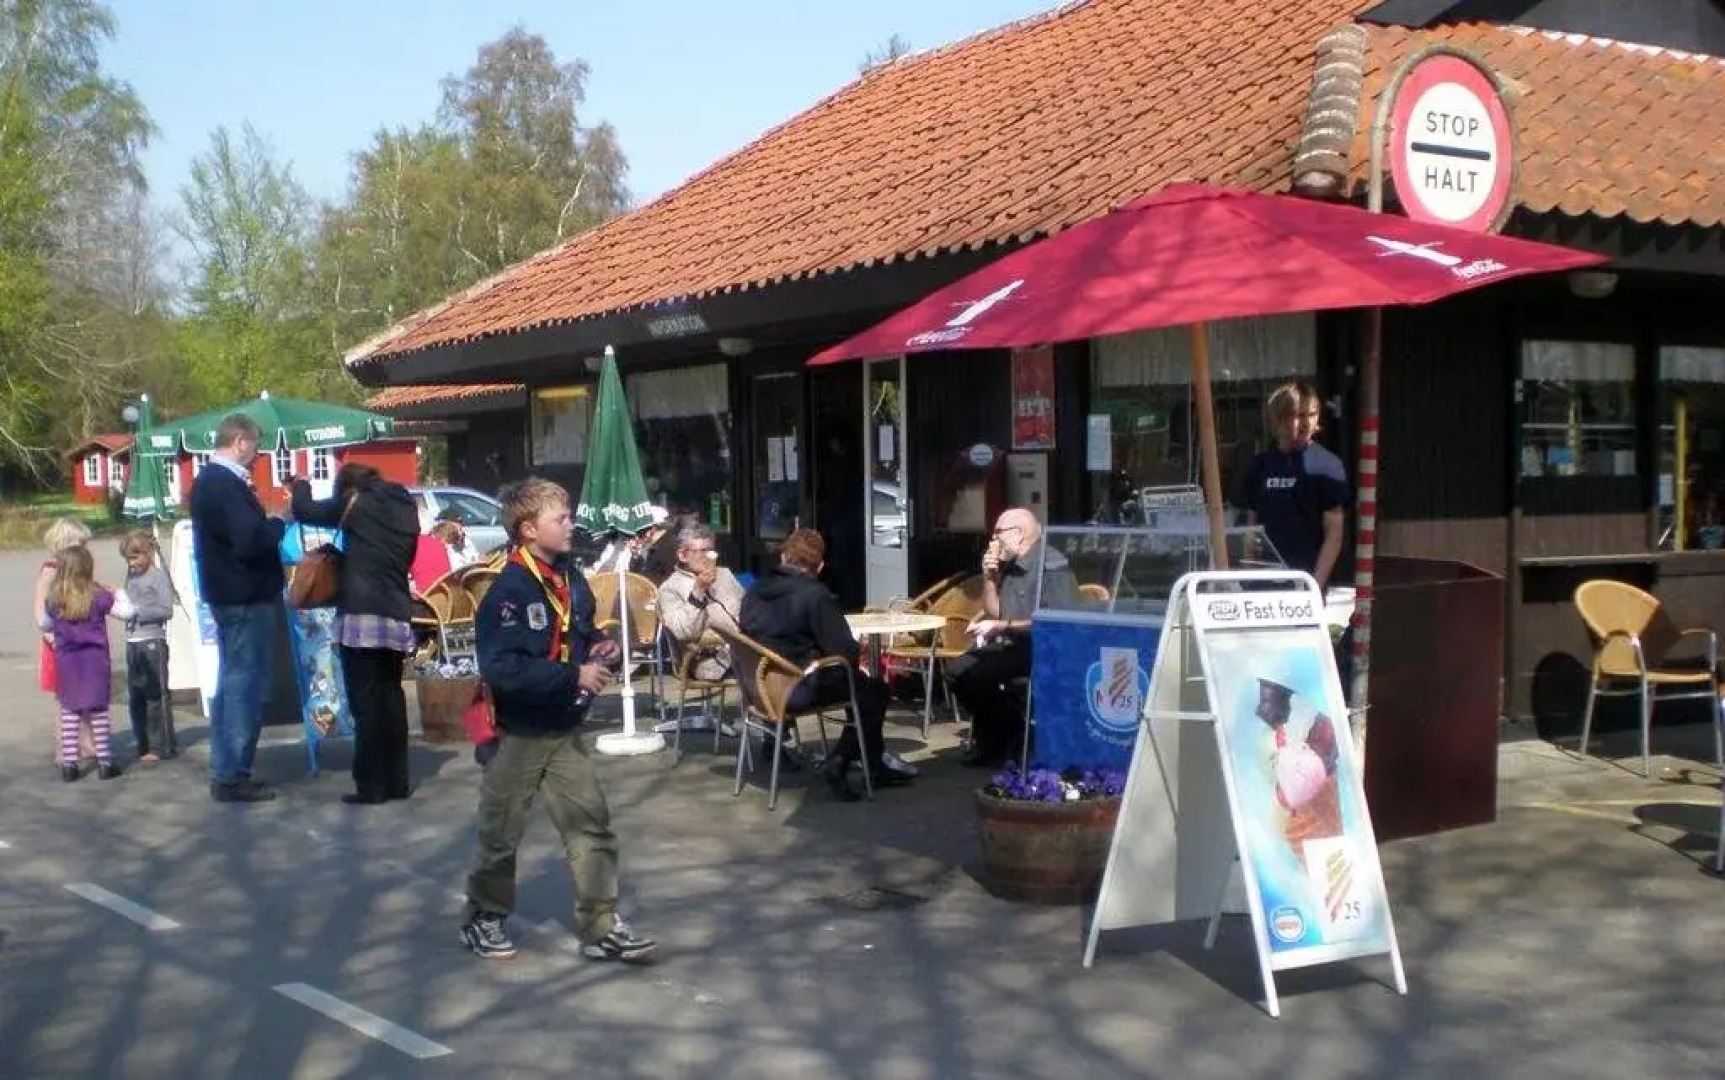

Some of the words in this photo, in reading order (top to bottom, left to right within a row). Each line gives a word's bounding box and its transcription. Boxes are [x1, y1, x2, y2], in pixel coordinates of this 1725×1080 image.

[1426, 110, 1480, 137] STOP
[1425, 166, 1479, 193] HALT
[1244, 600, 1275, 619] Fast
[1279, 599, 1314, 618] food
